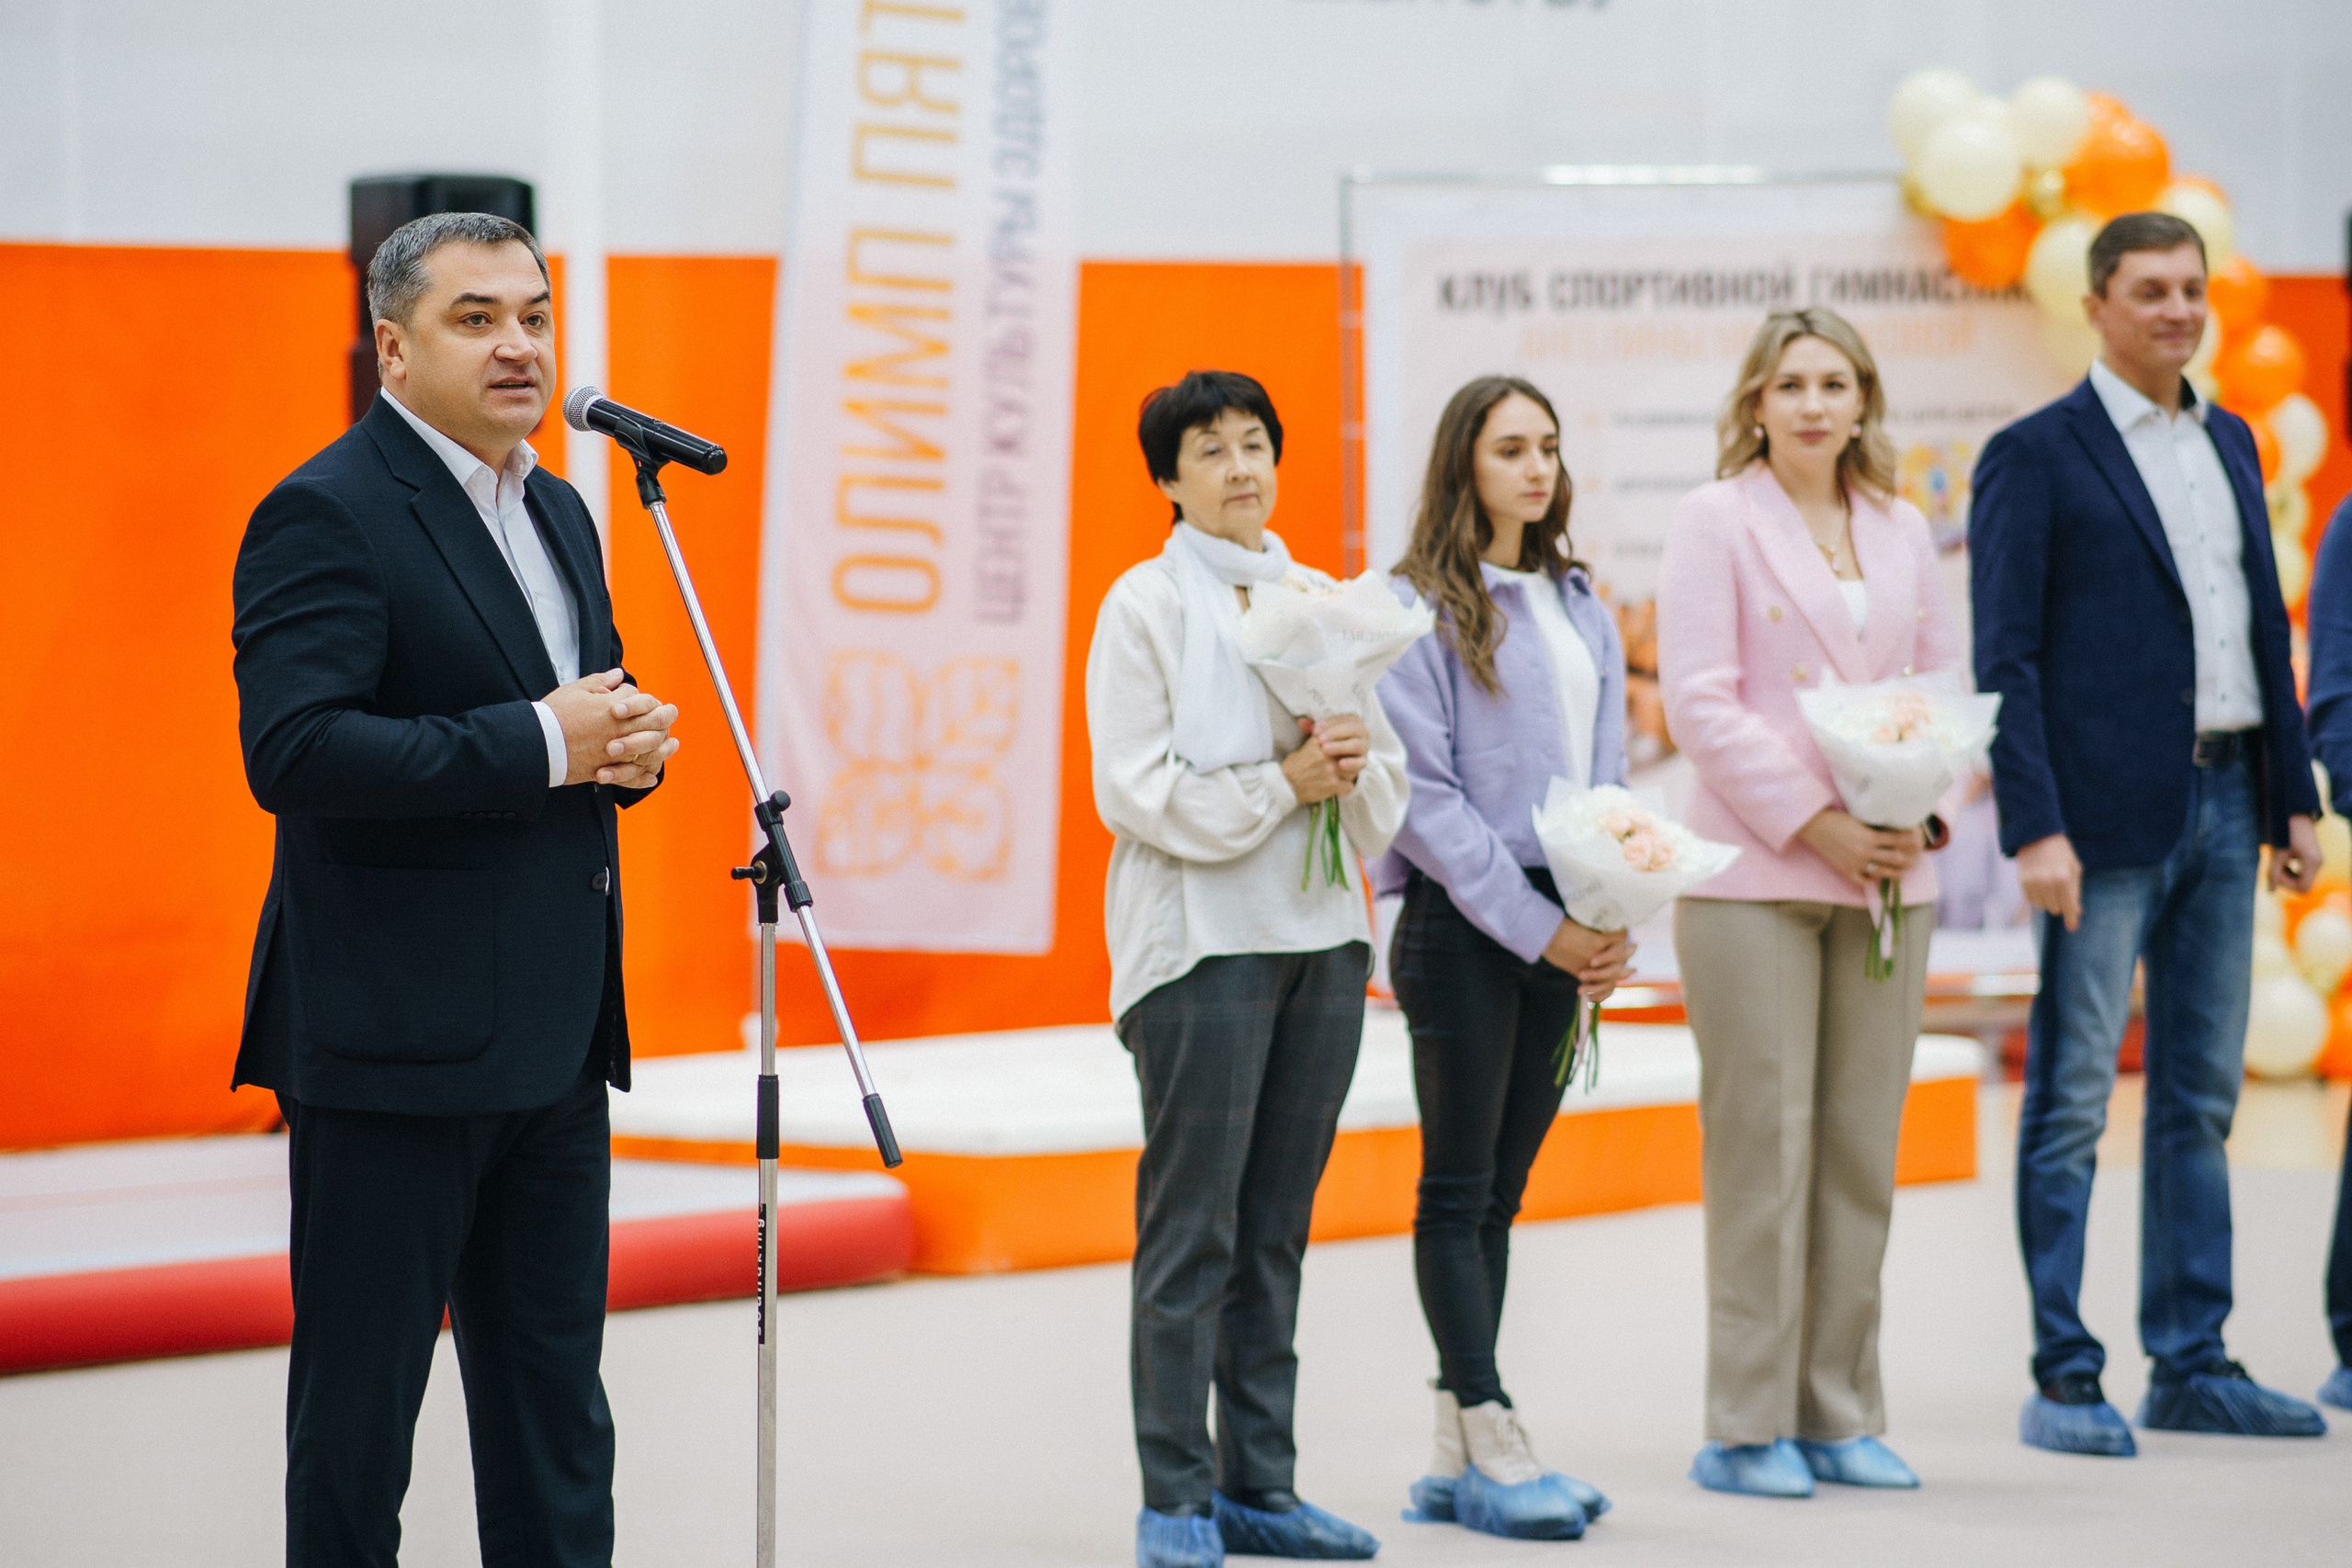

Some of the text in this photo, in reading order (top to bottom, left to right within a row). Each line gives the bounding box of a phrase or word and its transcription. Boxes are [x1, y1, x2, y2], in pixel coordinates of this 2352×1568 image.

[983, 189, 1040, 456] КУЛЬТУРЫ
[1436, 269, 1533, 318] КЛУБ
[1548, 264, 1796, 310] СПОРТИВНОЙ
[831, 227, 956, 615] ОЛИМП
[974, 467, 1031, 626] ЦЕНТР
